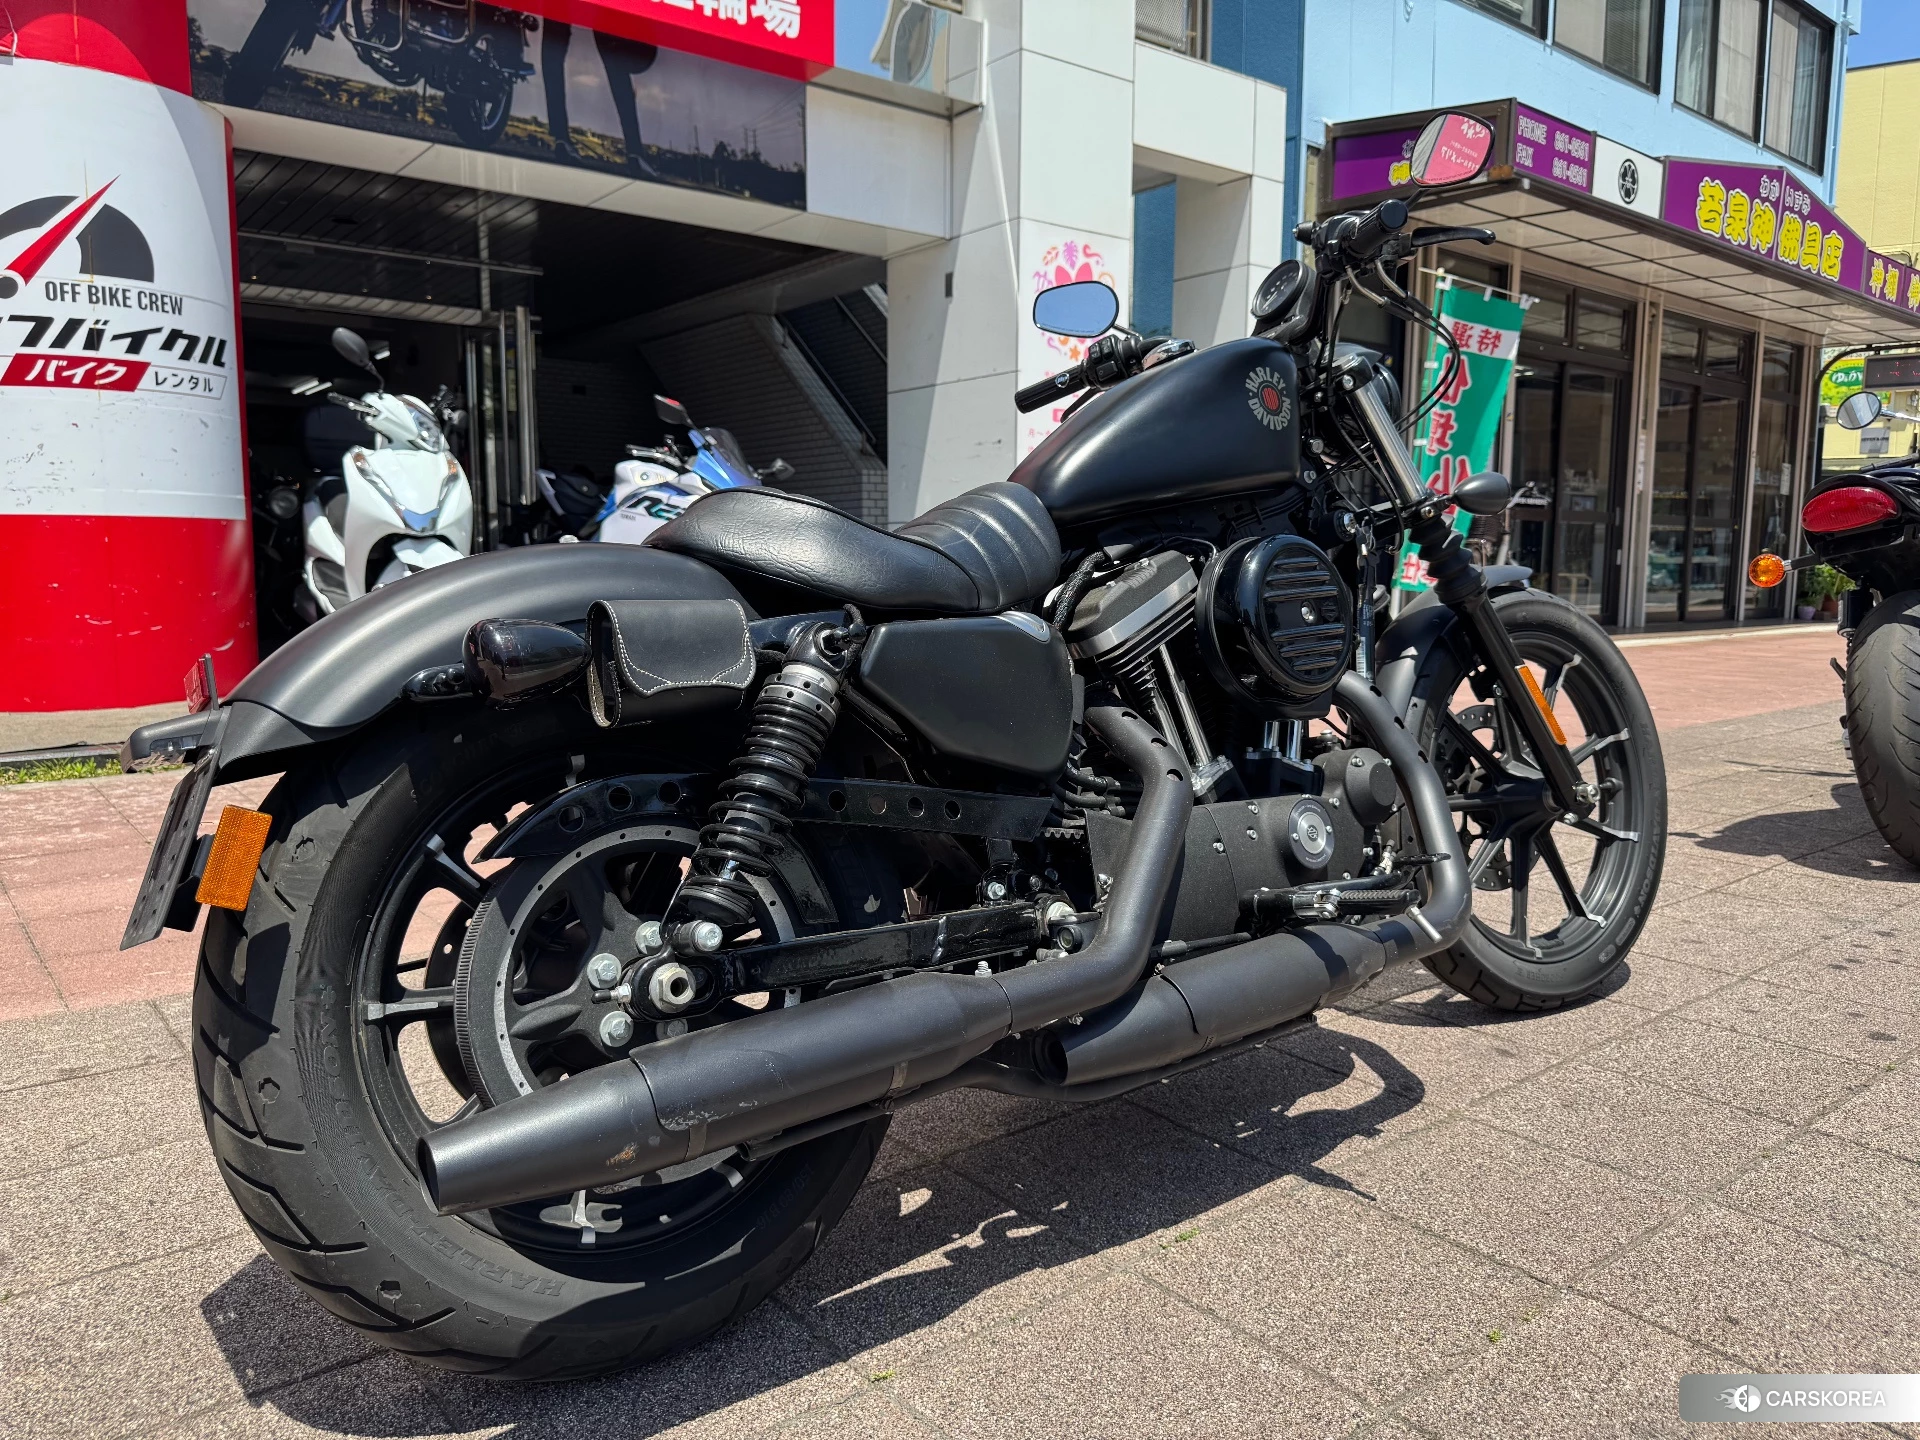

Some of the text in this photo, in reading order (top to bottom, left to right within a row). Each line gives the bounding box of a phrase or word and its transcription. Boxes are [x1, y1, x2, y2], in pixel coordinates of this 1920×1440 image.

[1518, 115, 1547, 145] PHONE
[1516, 142, 1534, 167] FAX
[45, 281, 183, 316] OFF BIKE CREW
[0, 313, 228, 368] フバイクル
[24, 359, 128, 386] バイク
[154, 370, 214, 393] レンタル
[1245, 366, 1286, 393] HARLEY
[1247, 396, 1292, 431] DAVIDSON
